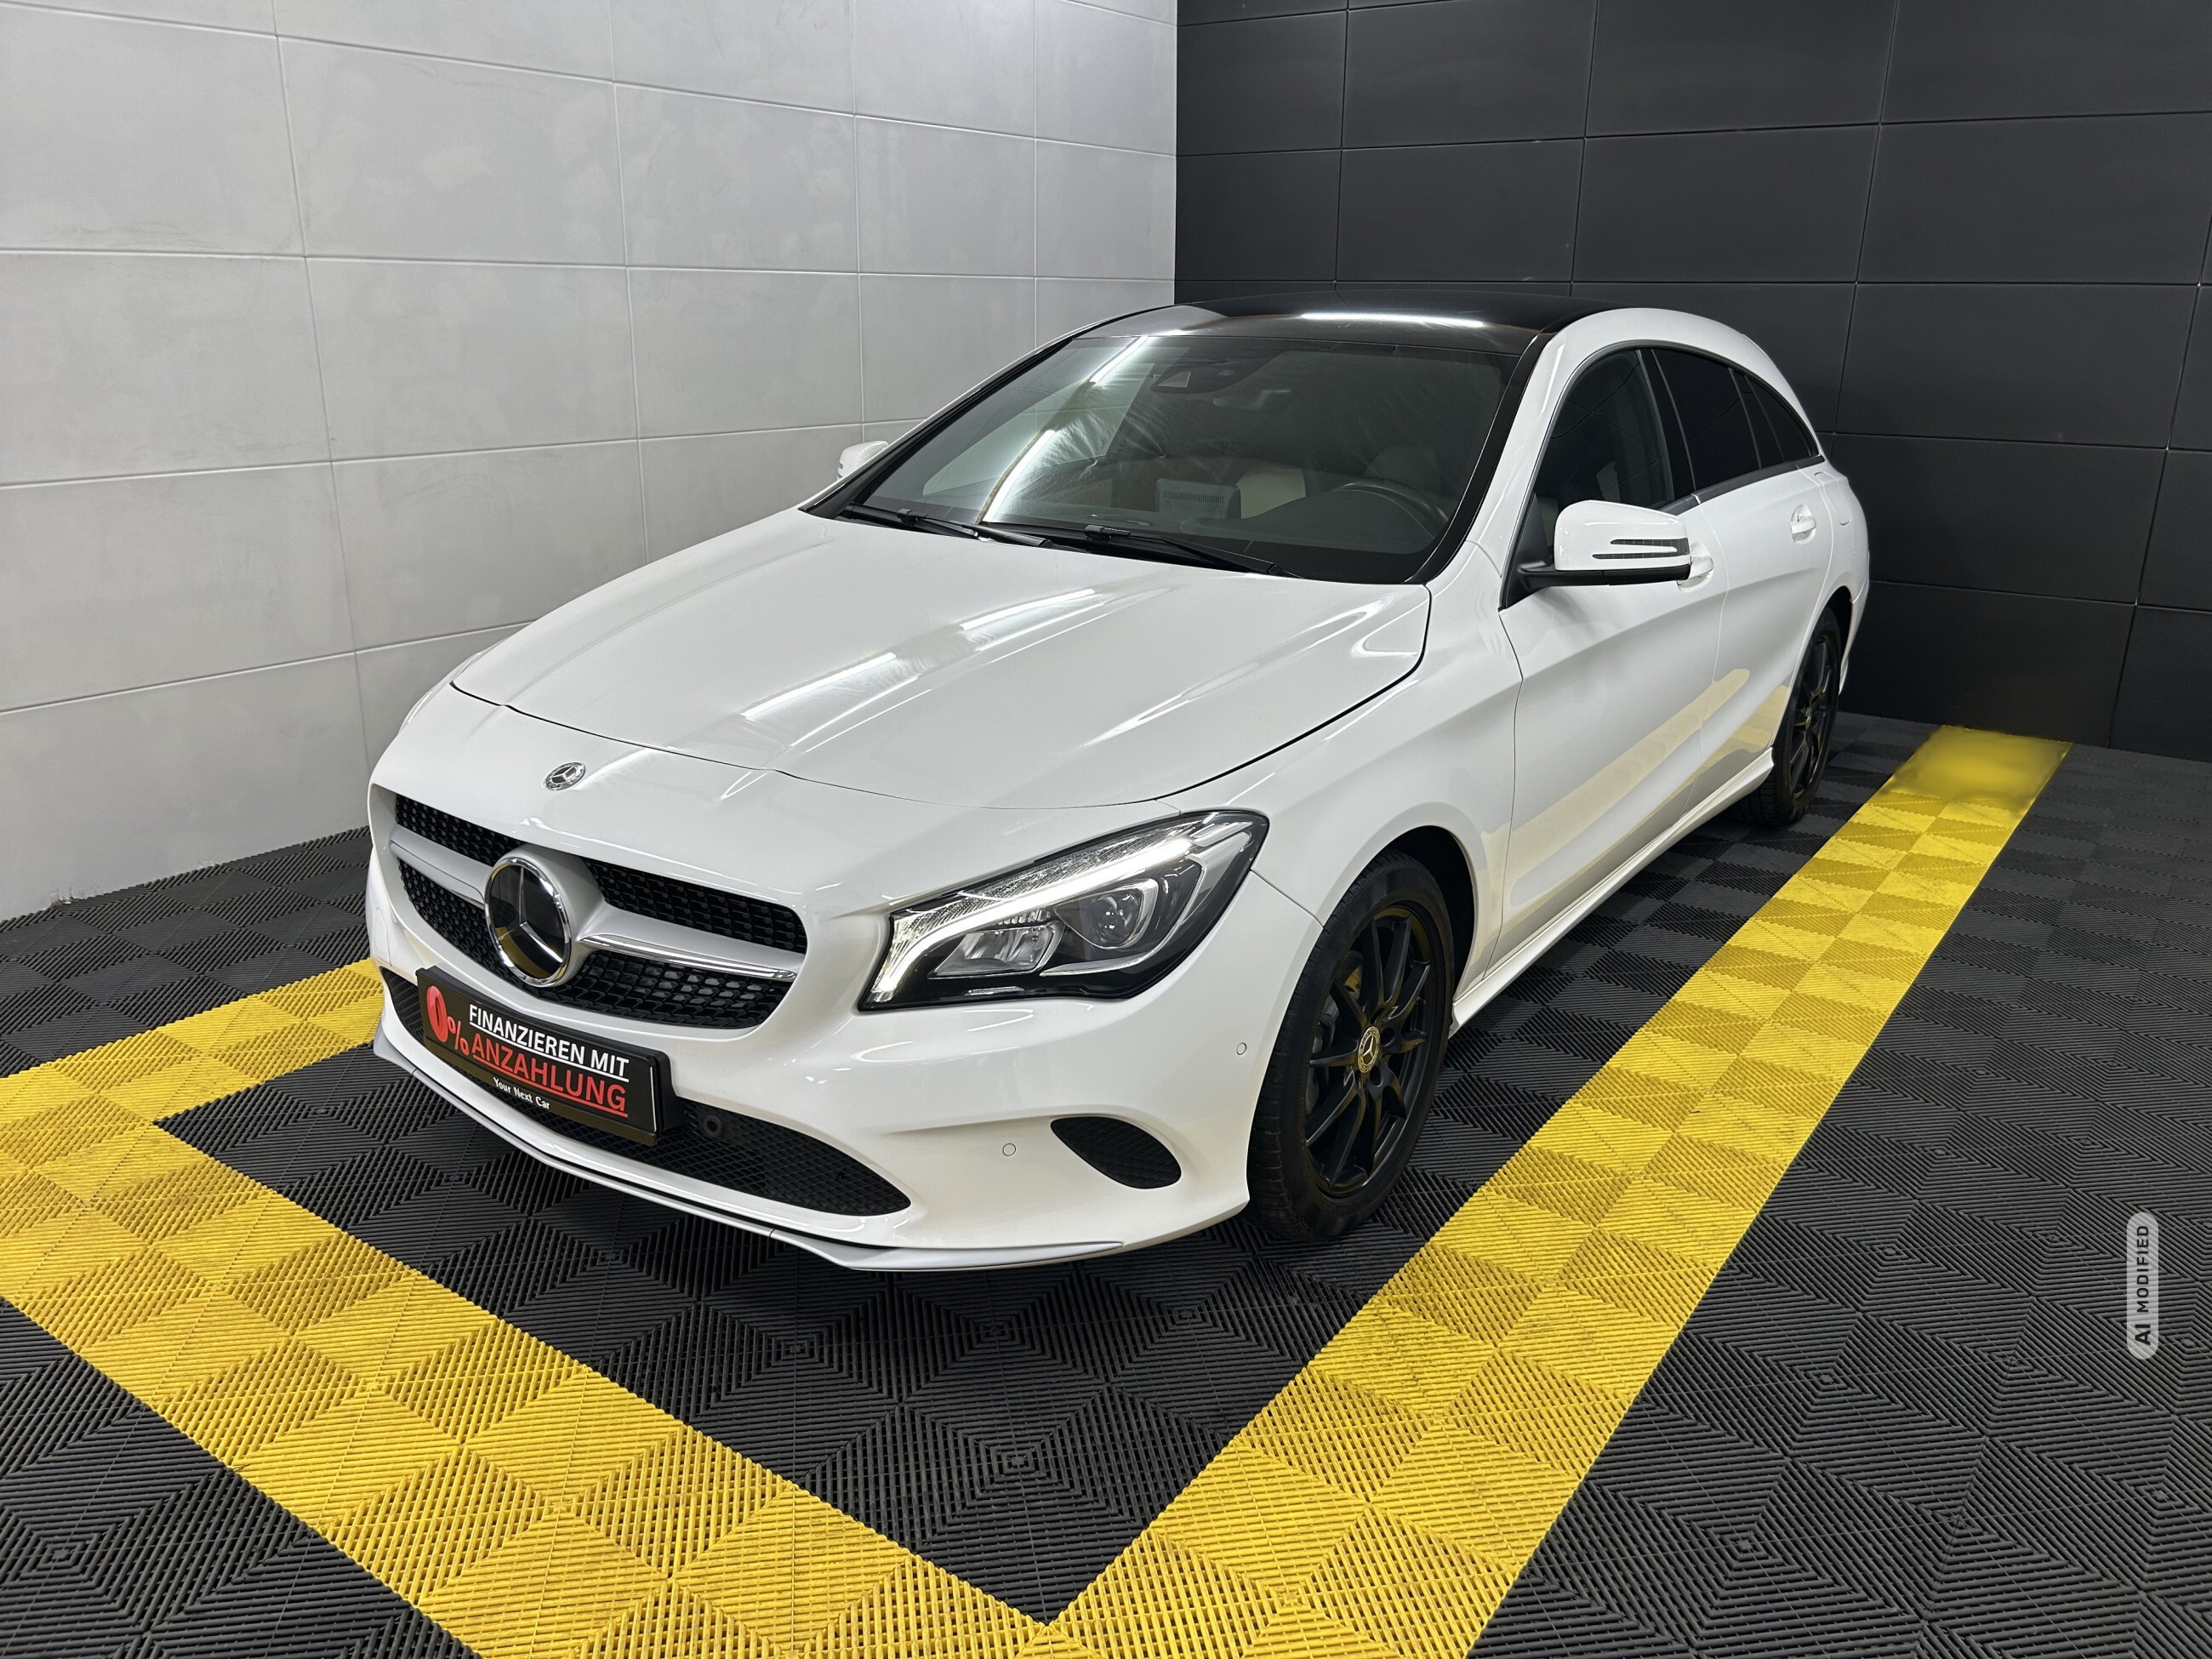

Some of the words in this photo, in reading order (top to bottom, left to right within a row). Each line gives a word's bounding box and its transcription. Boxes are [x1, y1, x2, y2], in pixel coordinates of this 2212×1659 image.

[469, 1004, 585, 1064] FINANZIEREN
[590, 1049, 630, 1077] MIT
[472, 1033, 627, 1112] ANZAHLUNG
[493, 1076, 511, 1093] Your
[513, 1086, 533, 1103] Next
[535, 1096, 550, 1109] Car
